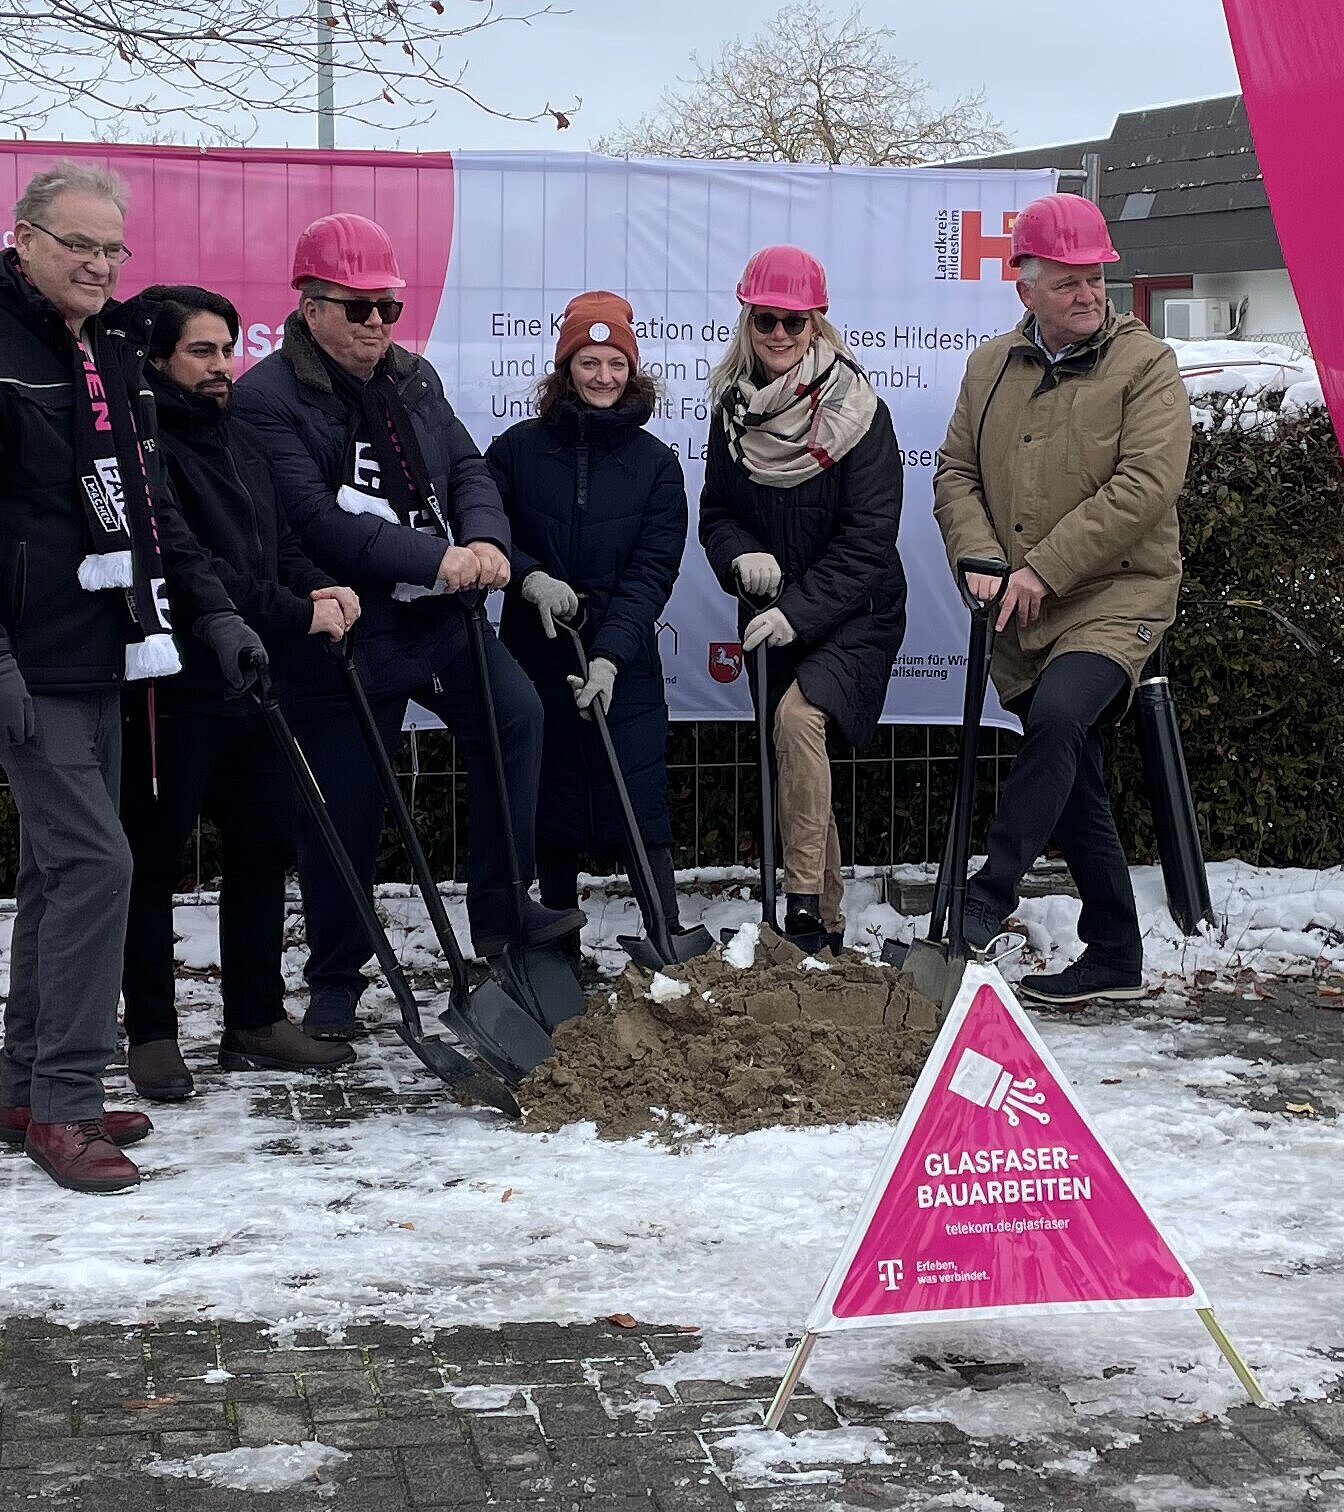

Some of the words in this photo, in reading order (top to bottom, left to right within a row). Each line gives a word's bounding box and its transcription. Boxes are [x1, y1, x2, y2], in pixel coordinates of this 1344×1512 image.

[934, 209, 948, 280] Landkreis
[948, 209, 960, 280] Hildesheim
[491, 313, 542, 337] Eine
[491, 353, 536, 377] und
[927, 654, 945, 666] für
[891, 666, 948, 681] alisierung
[924, 1147, 1080, 1177] GLASFASER-
[917, 1176, 1093, 1209] BAUARBEITEN
[944, 1217, 1071, 1237] telekom.de/glasfaser
[917, 1275, 938, 1285] was
[939, 1270, 991, 1284] verbindet.
